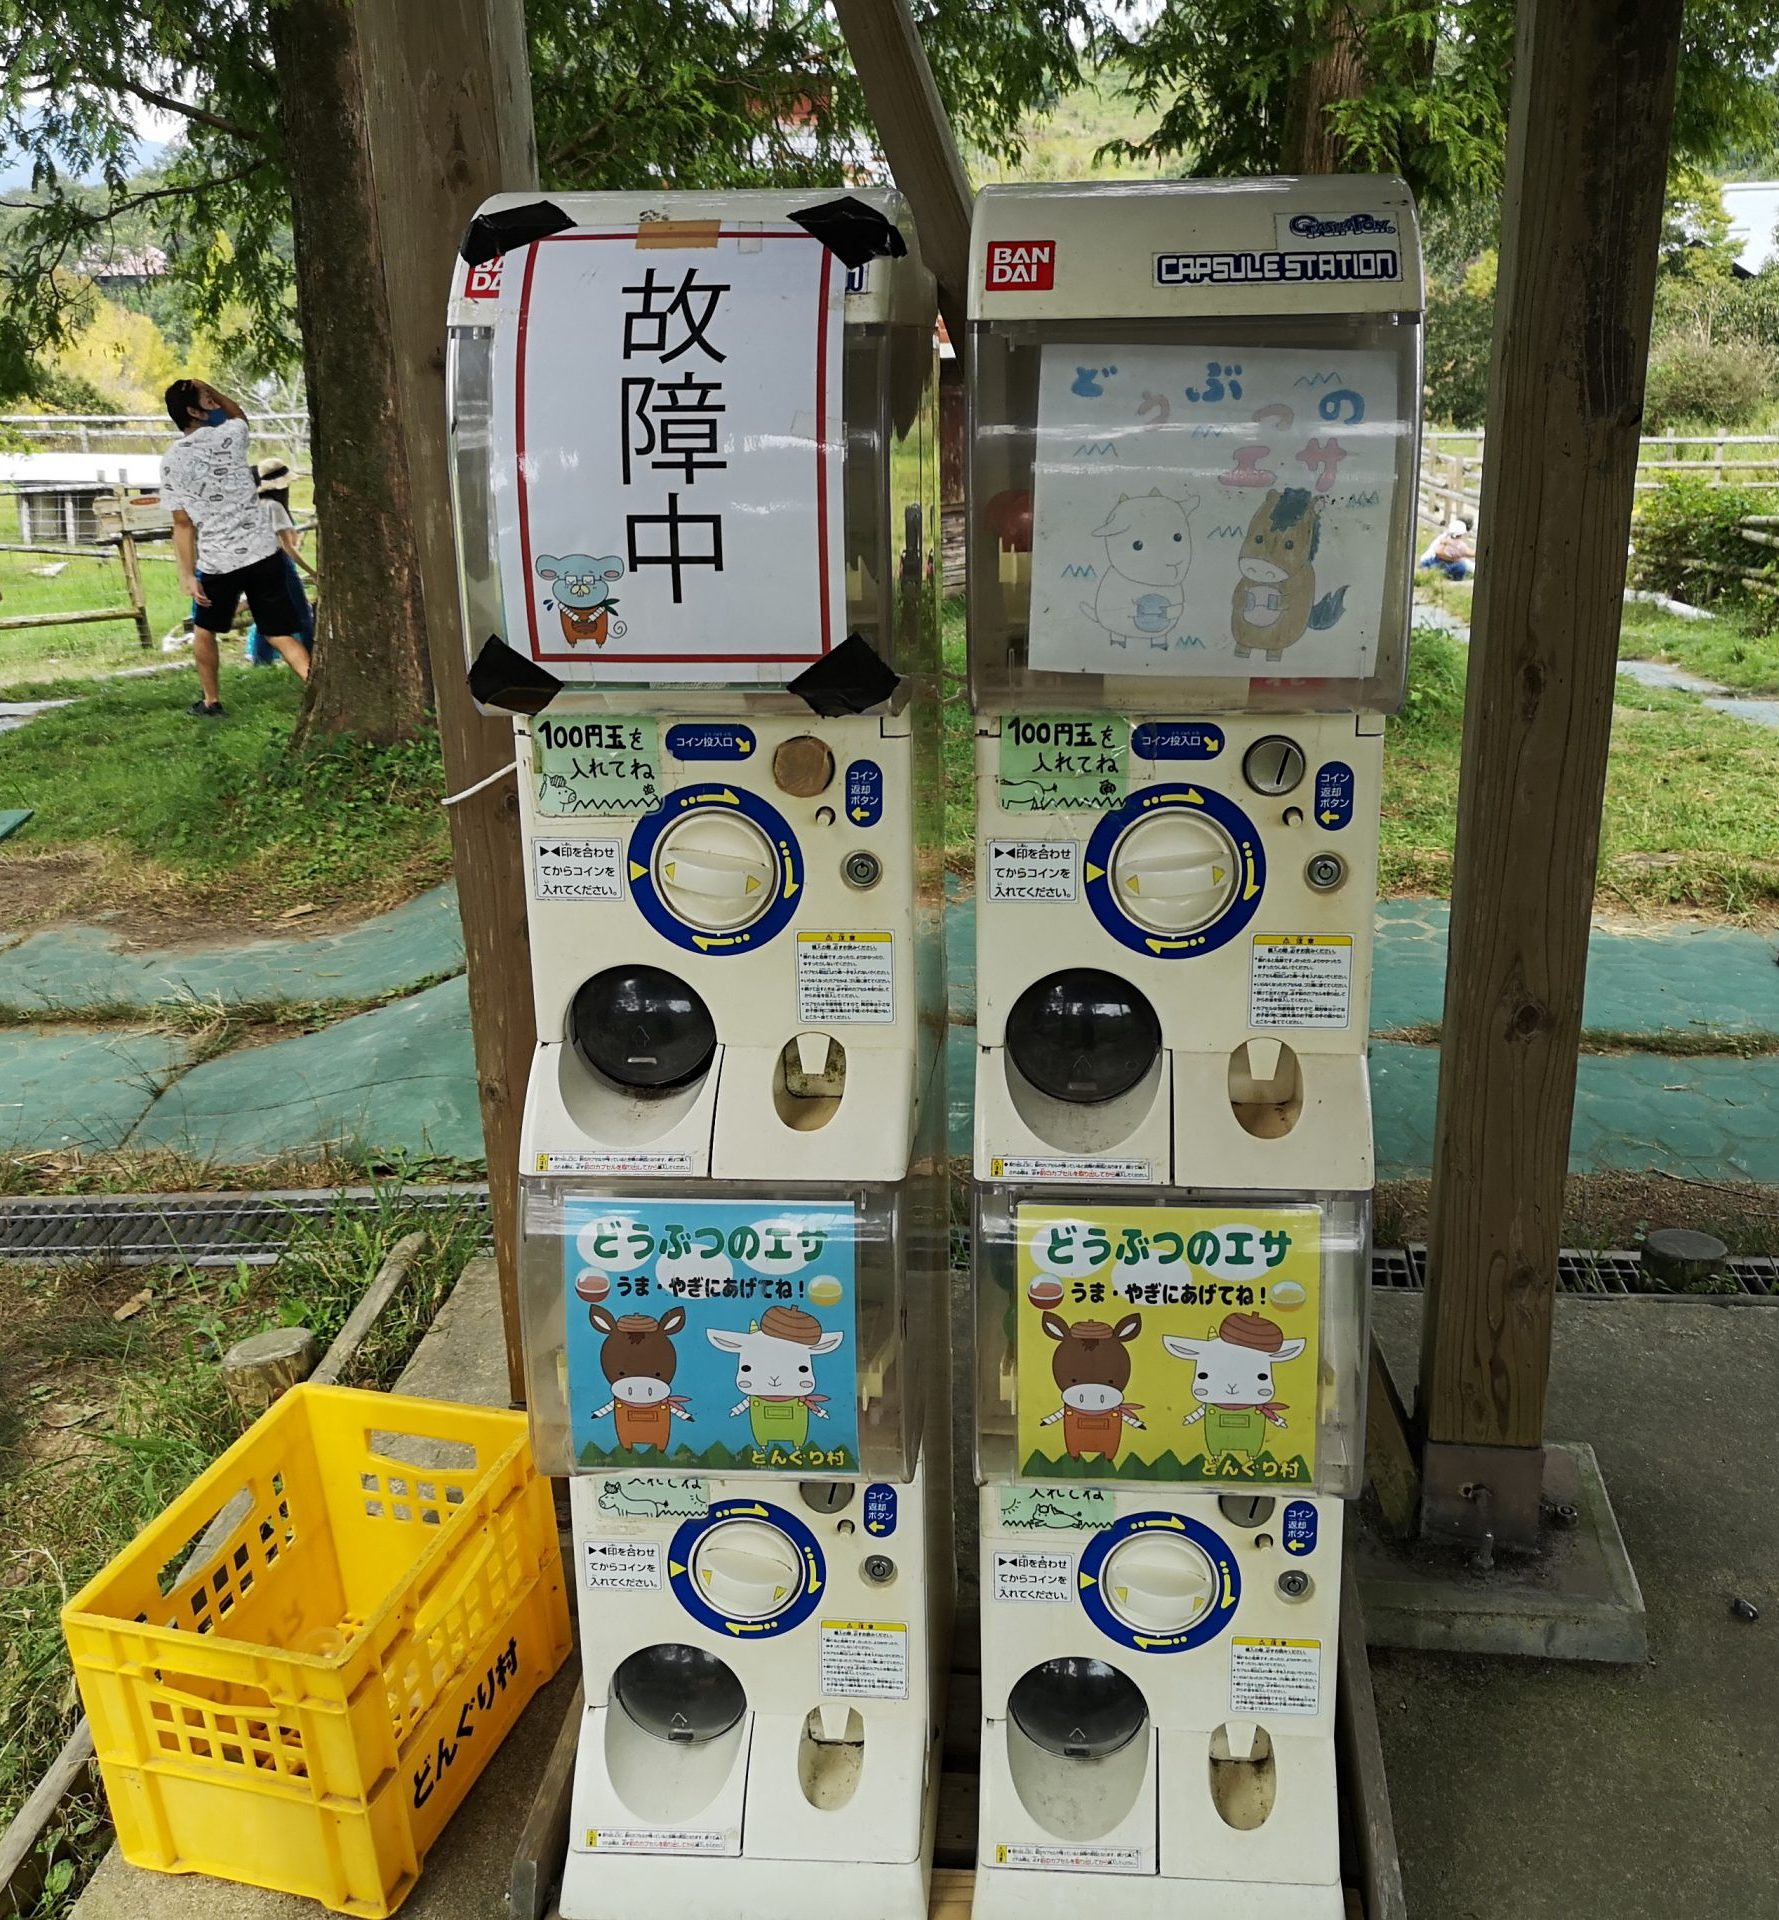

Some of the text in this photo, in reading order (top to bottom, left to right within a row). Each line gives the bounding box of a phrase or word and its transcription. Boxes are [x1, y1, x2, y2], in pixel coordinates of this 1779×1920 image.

[993, 246, 1050, 264] BAN
[1160, 252, 1394, 281] CAPSULE STATION
[992, 264, 1038, 283] DAI
[471, 272, 502, 291] DA
[621, 267, 731, 604] 故障中
[1217, 437, 1349, 492] エサ
[538, 720, 645, 751] 100円玉を
[1007, 720, 1117, 749] 100円玉を
[1141, 735, 1201, 747] コイン投入口
[676, 736, 733, 748] コイン投入口
[569, 757, 656, 780] 入れてね
[1031, 752, 1119, 775] 入れてね
[850, 770, 879, 781] コイン
[1320, 772, 1350, 783] コイン
[850, 784, 871, 796] 返却
[1320, 787, 1342, 798] 返却
[850, 795, 880, 806] ボタン
[1320, 797, 1350, 809] ボタン
[540, 865, 615, 878] てからコインを
[994, 866, 1071, 880] てからコインを
[542, 884, 620, 897] 入れてください。
[994, 885, 1073, 899] 入れてください。
[593, 1220, 829, 1262] どうぶつのエサ
[1047, 1224, 1293, 1268] どうぶつのエサ
[751, 1449, 845, 1466] どんぐり村
[1201, 1459, 1300, 1478] どんぐり村
[867, 1492, 894, 1501] コイン
[867, 1503, 887, 1512] 返却
[1287, 1510, 1314, 1518] コイン
[867, 1511, 894, 1520] ボタン
[1287, 1520, 1307, 1530] 返却
[1287, 1530, 1314, 1538] ボタン
[589, 1562, 656, 1573] てからコインを
[590, 1577, 659, 1589] 入れてください。
[998, 1573, 1067, 1585] てからコインを
[998, 1588, 1068, 1600] 入れてください。
[413, 1636, 518, 1809] どんぐり村
